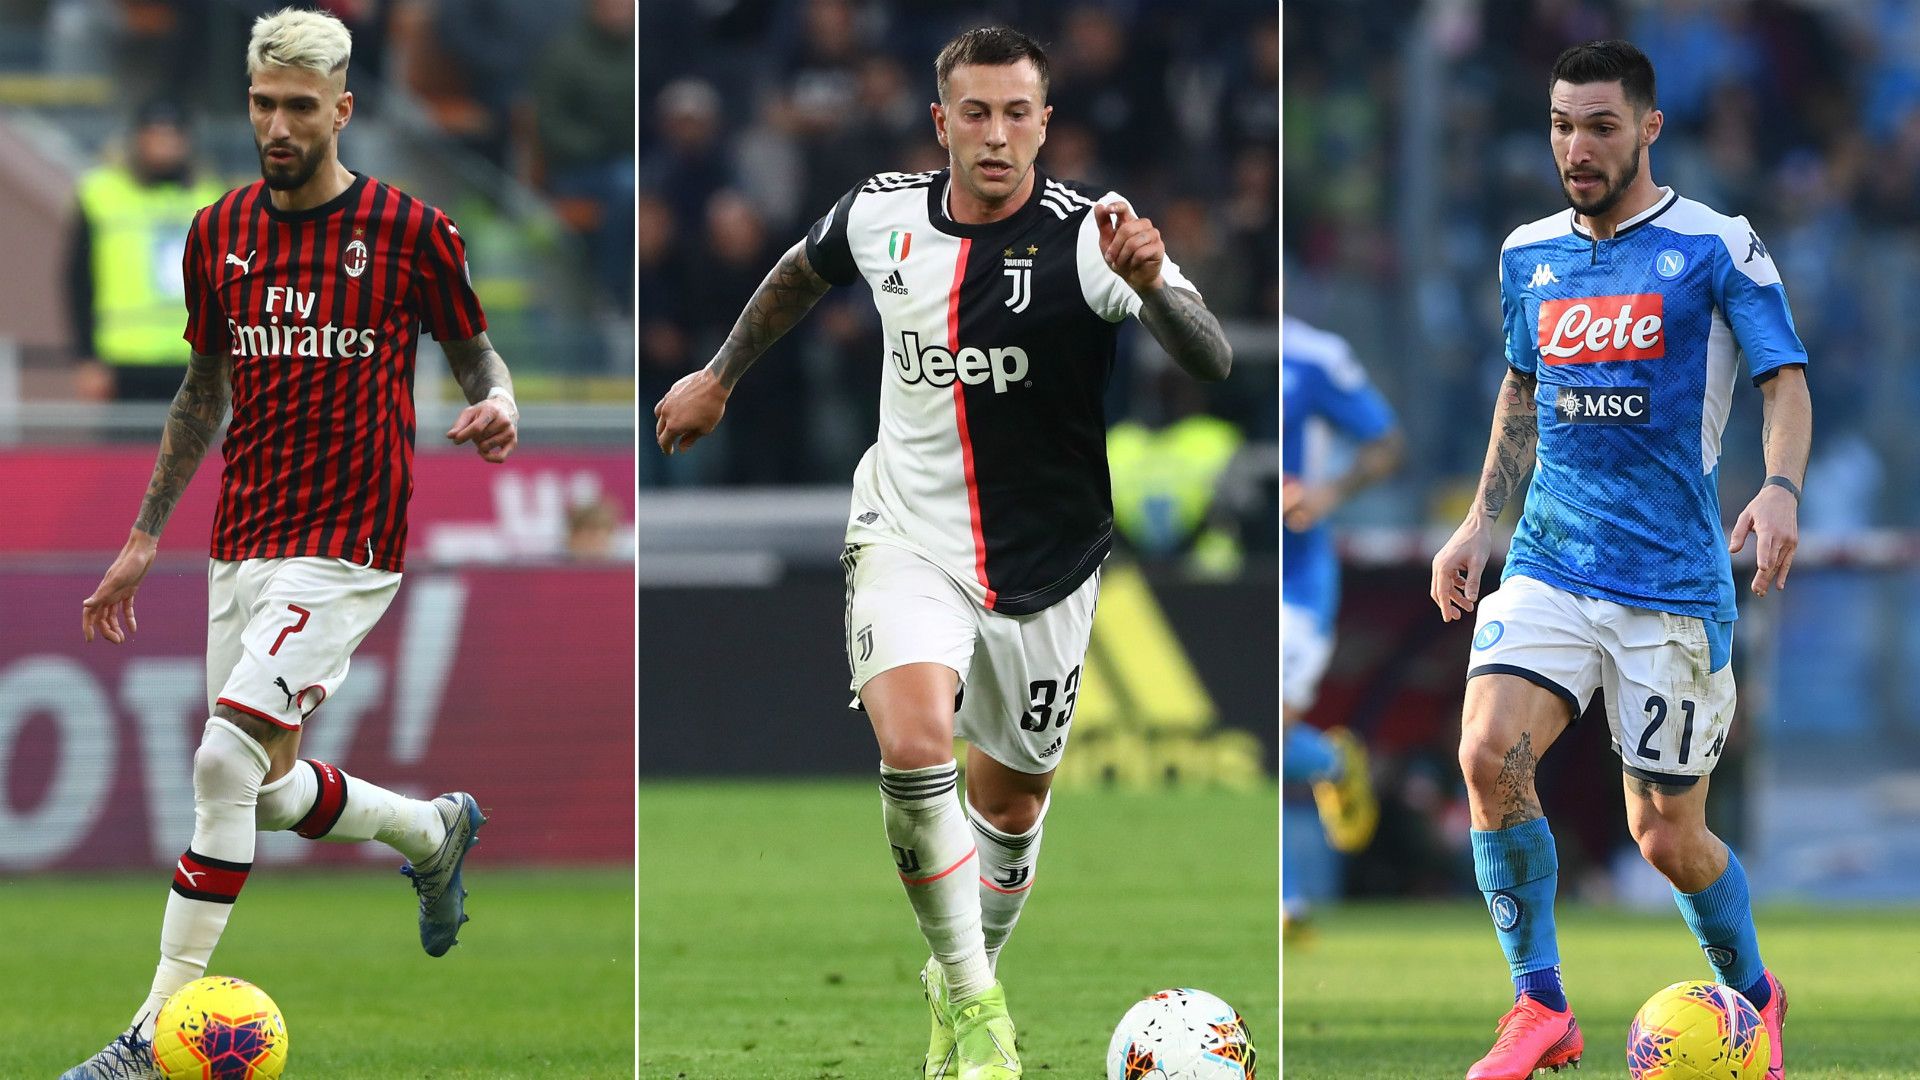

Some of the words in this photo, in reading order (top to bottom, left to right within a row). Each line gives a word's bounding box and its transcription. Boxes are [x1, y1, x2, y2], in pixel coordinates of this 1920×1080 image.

[1003, 258, 1033, 267] JUVENTUS
[1662, 255, 1681, 273] N
[266, 286, 315, 319] Fly
[881, 283, 909, 296] adidas
[228, 317, 375, 358] Emirates
[1539, 303, 1663, 357] Lete
[893, 331, 1029, 394] Jeep
[1584, 395, 1644, 417] MSC
[269, 604, 310, 656] 7
[1480, 624, 1497, 645] N
[1020, 664, 1080, 732] 33
[1636, 695, 1695, 765] 21
[1495, 901, 1511, 923] N
